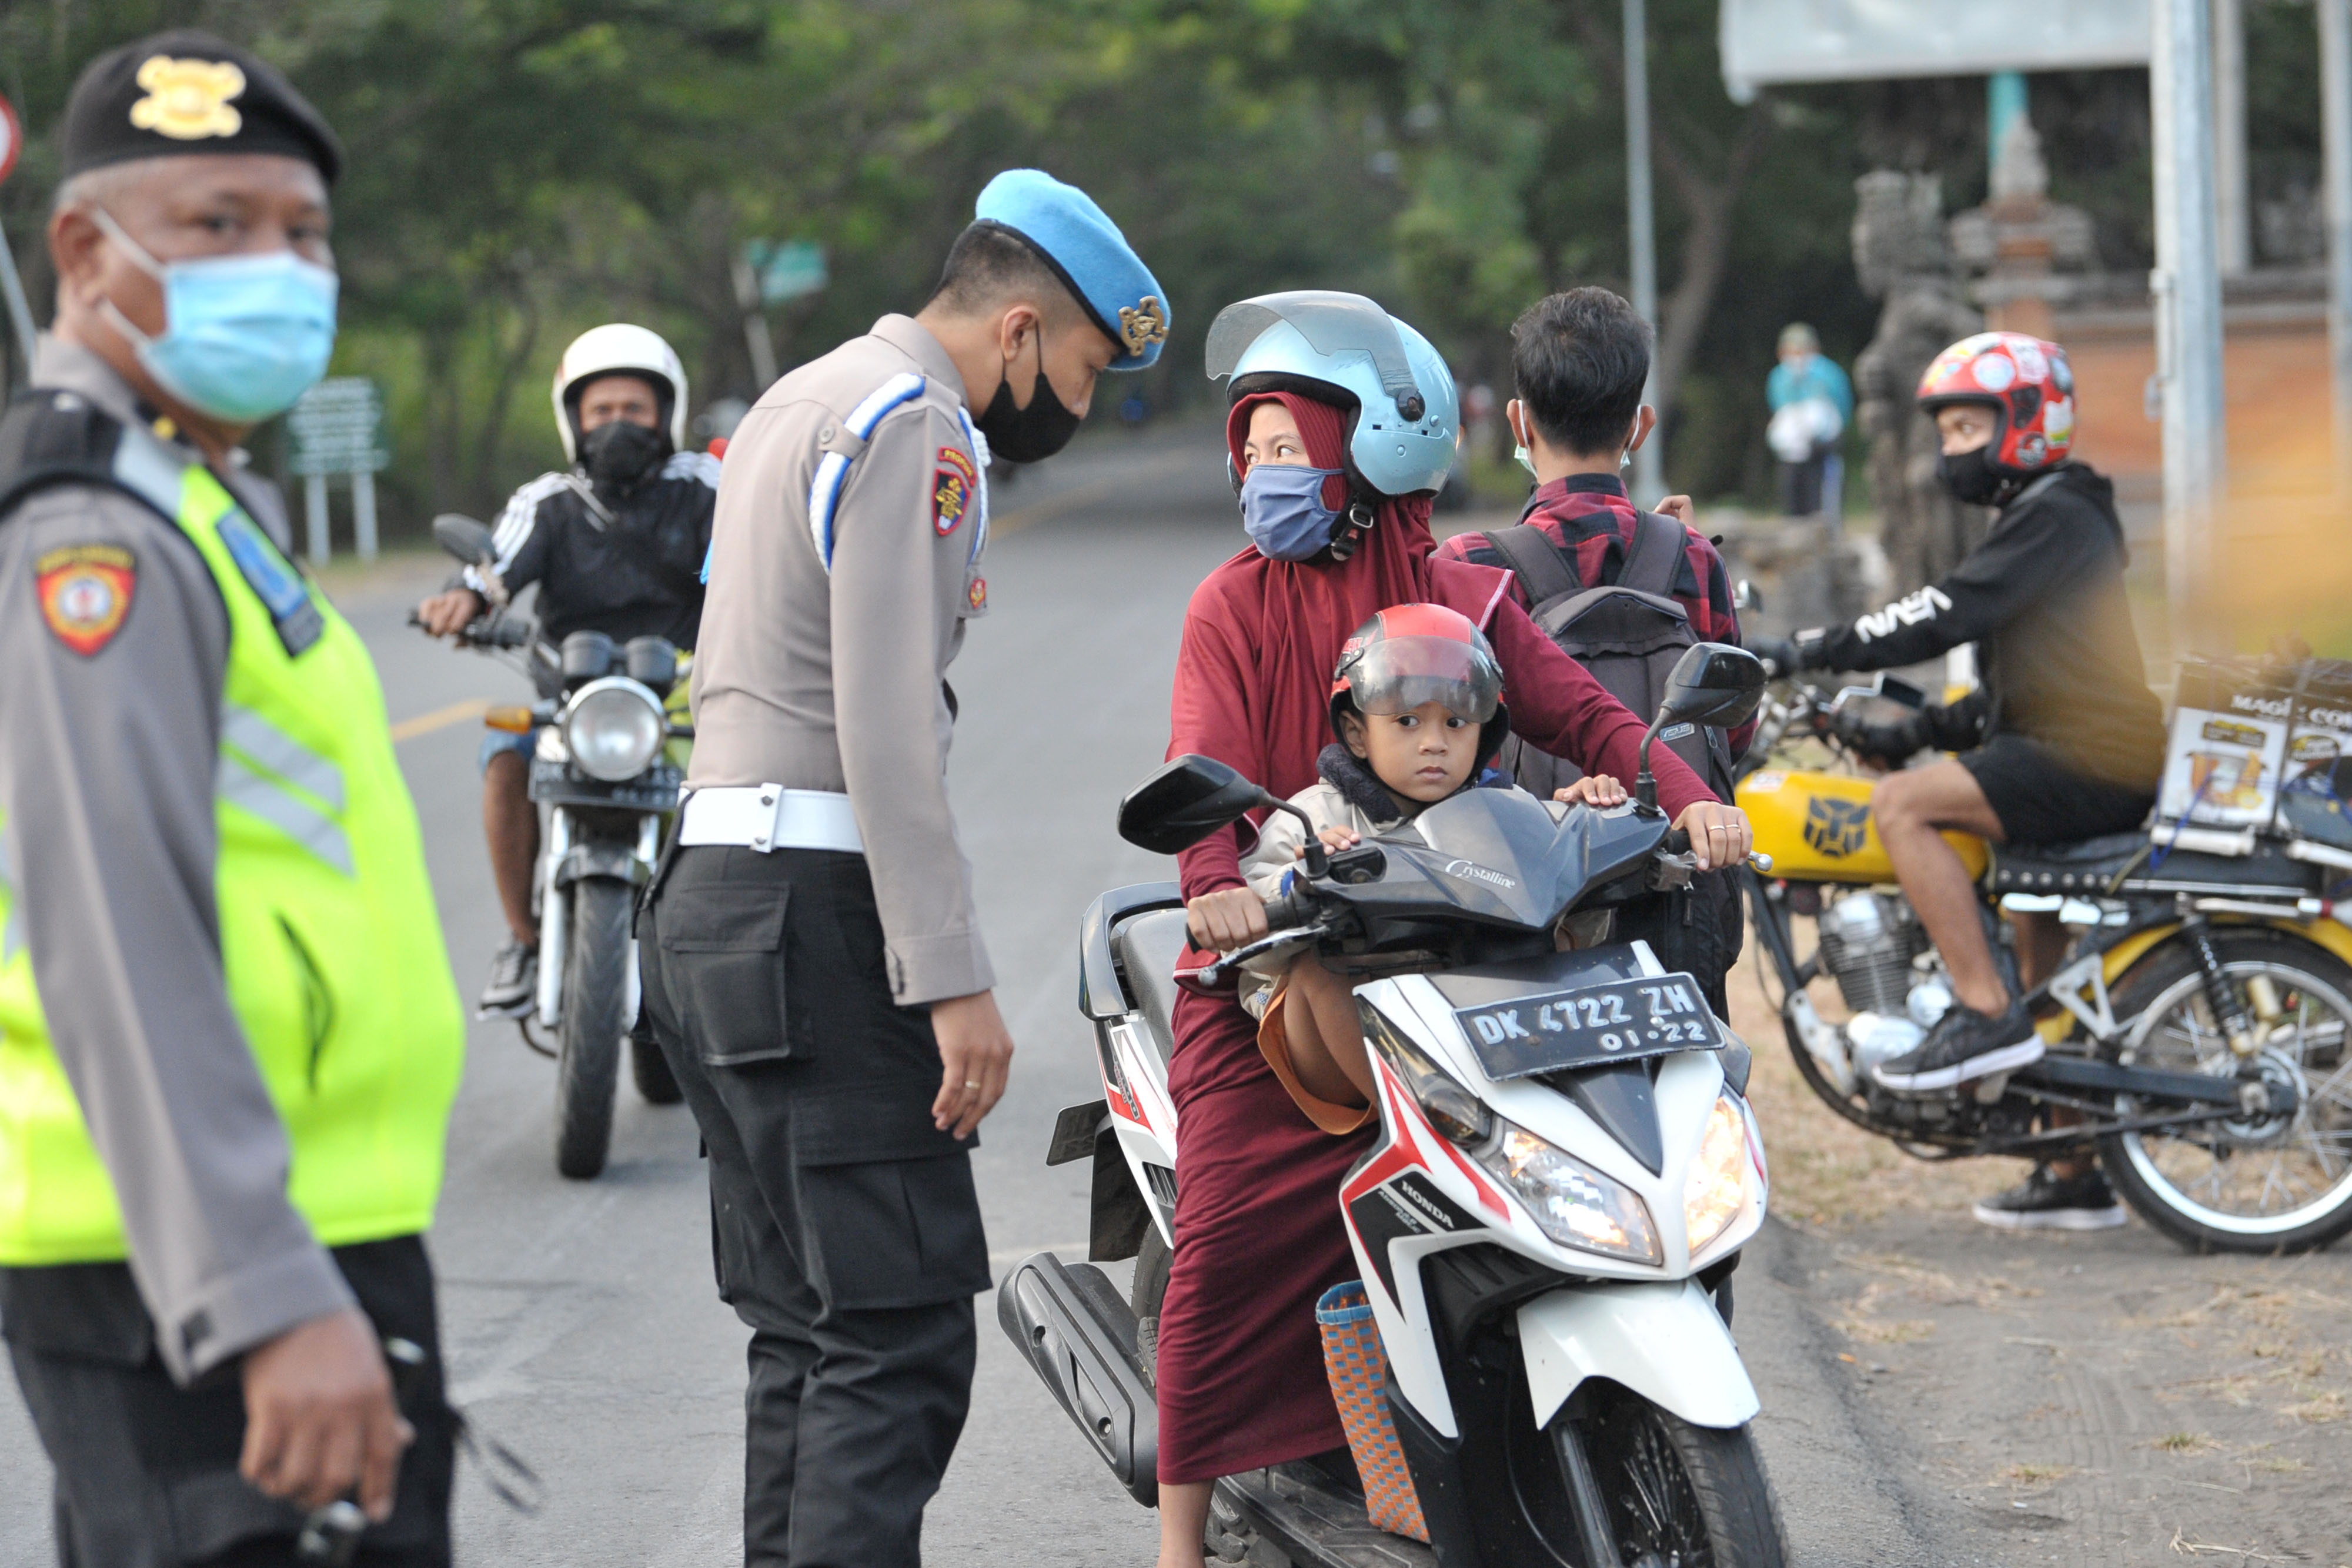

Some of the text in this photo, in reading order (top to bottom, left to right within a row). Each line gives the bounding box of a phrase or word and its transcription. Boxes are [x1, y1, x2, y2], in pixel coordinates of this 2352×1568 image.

[1855, 586, 1953, 644] NASA
[1445, 859, 1515, 890] Crystalline
[1473, 985, 1695, 1045] DK 4722 ZH
[1402, 1180, 1455, 1229] HONDA
